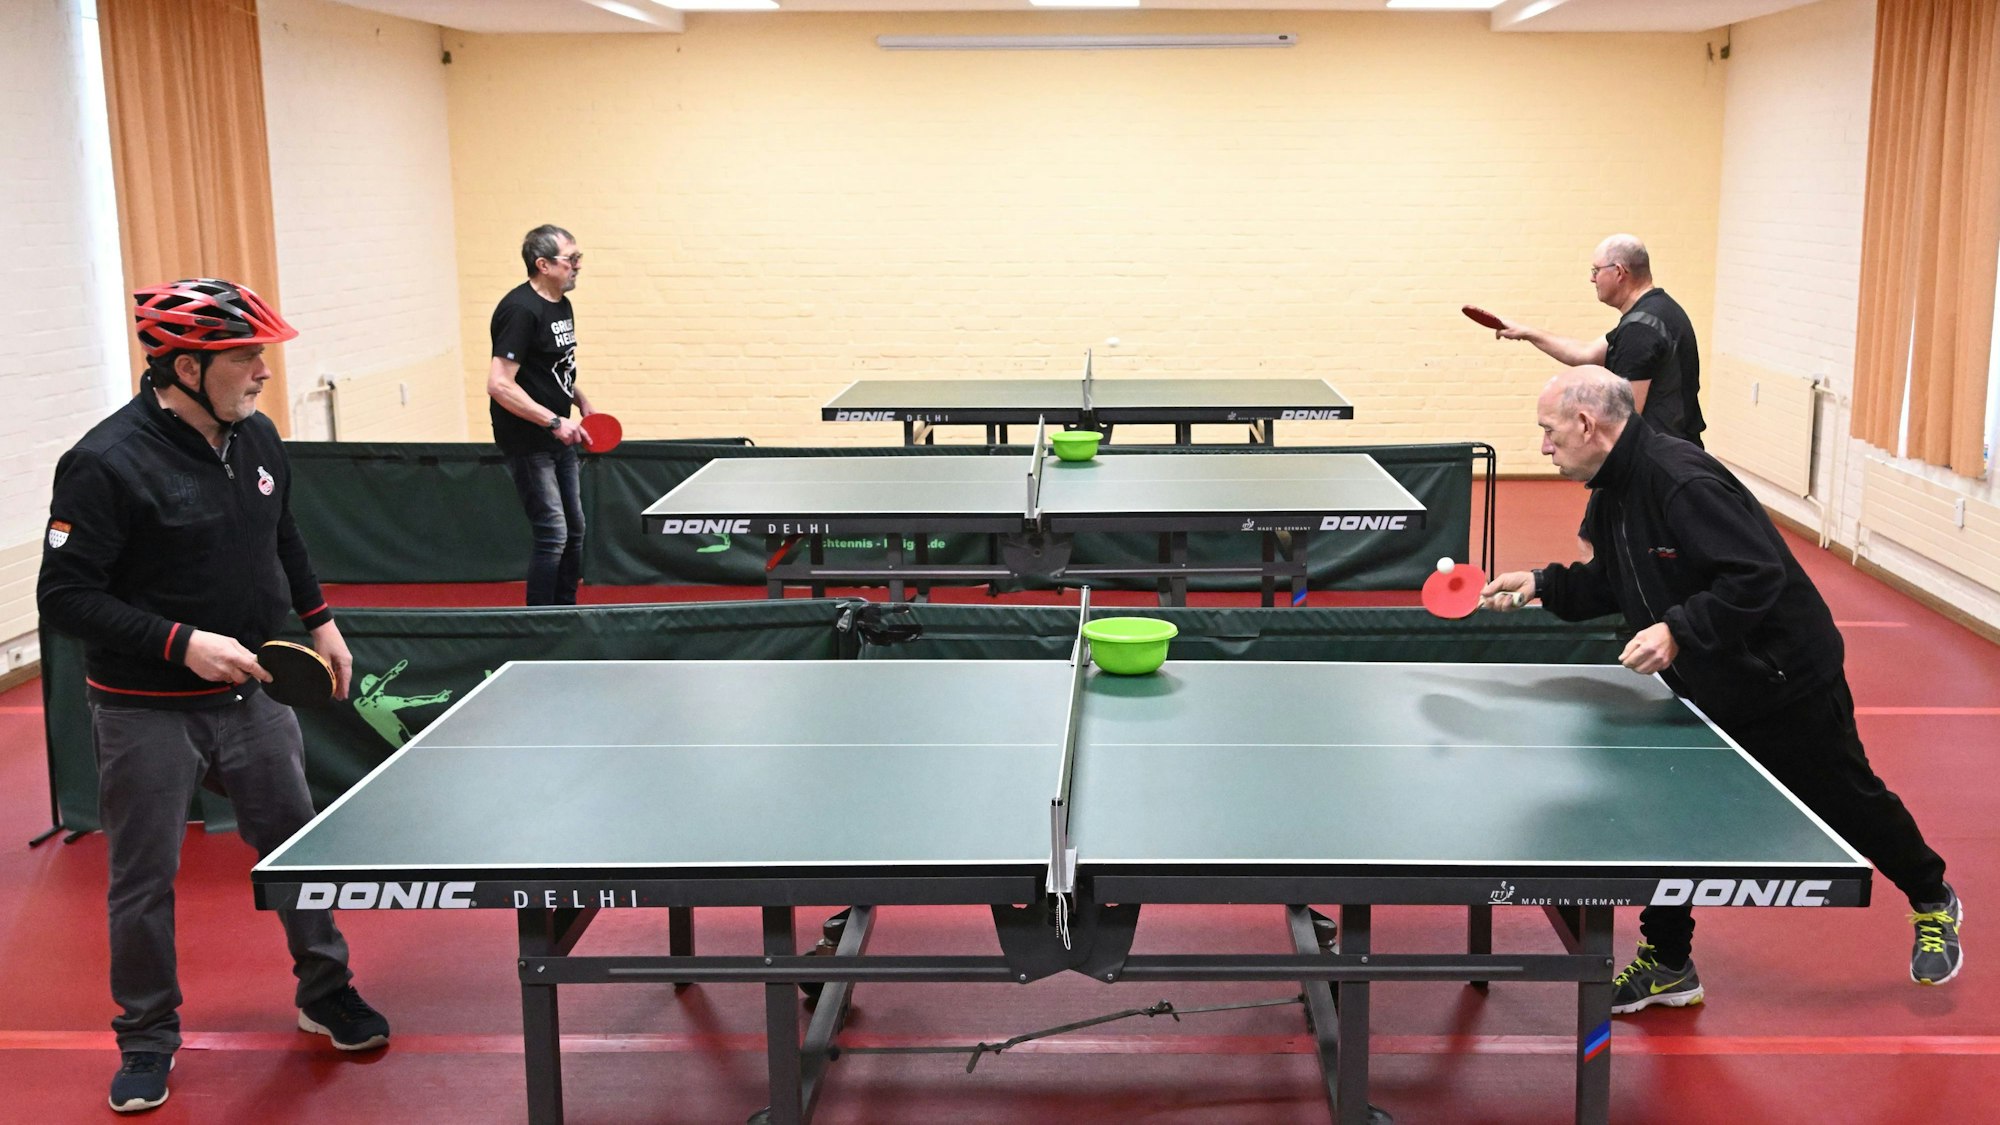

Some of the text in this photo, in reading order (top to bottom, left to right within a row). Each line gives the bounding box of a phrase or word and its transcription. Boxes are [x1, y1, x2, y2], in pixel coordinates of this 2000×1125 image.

[835, 411, 949, 422] DONIC DELHI
[1281, 410, 1341, 420] DONIC
[662, 519, 829, 534] DONIC DELHI
[1319, 516, 1408, 530] DONIC
[296, 882, 638, 909] DONIC DELHI
[1650, 879, 1832, 906] DONIC
